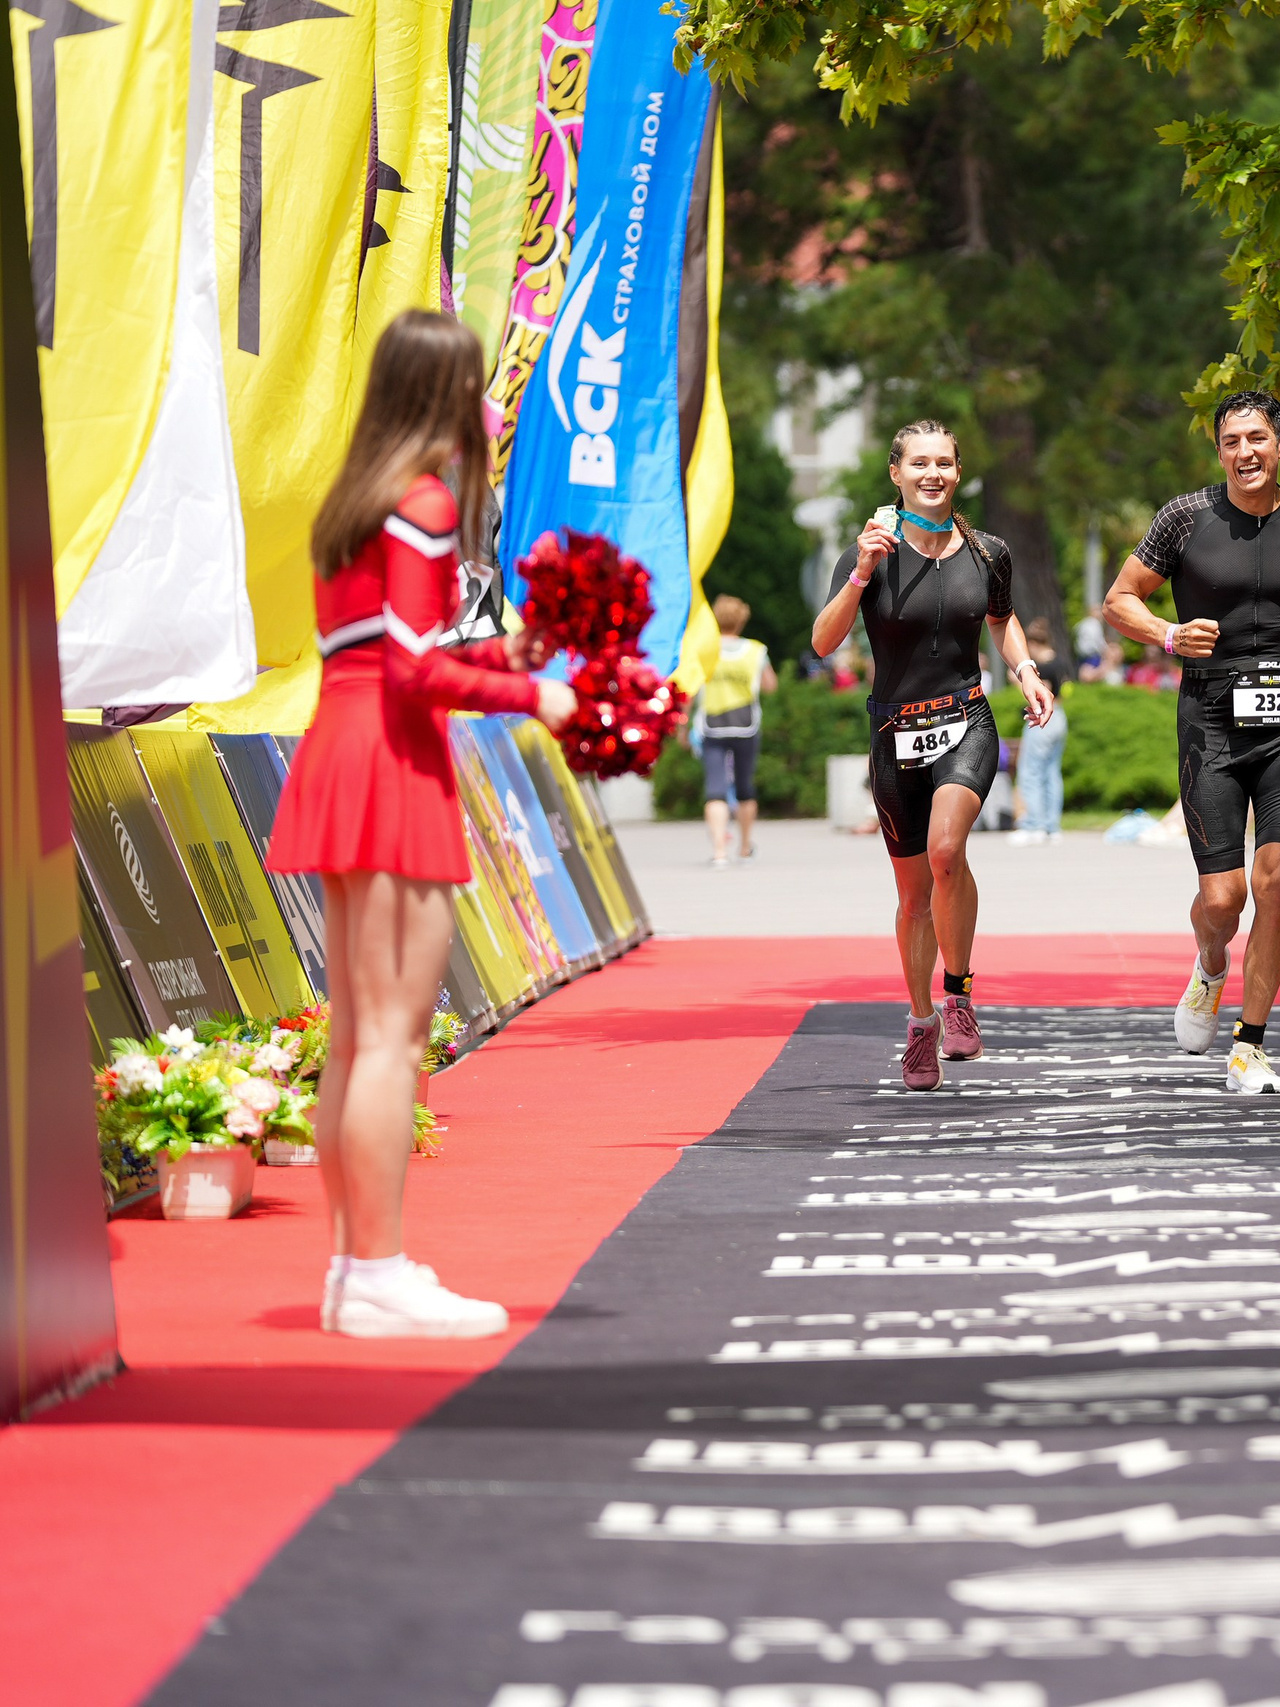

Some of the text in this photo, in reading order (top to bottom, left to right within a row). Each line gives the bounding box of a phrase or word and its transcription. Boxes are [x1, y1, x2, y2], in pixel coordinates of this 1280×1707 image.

[568, 91, 665, 488] ВСК СТРАХОВОЙ ДОМ
[900, 695, 954, 715] ZONE3
[912, 730, 951, 754] 484
[186, 843, 236, 927] IRON
[806, 1186, 1057, 1203] IRON
[771, 1253, 1057, 1269] IRON
[720, 1335, 1053, 1358] IRON
[642, 1438, 1042, 1465] IRON
[601, 1501, 1037, 1538] IRON
